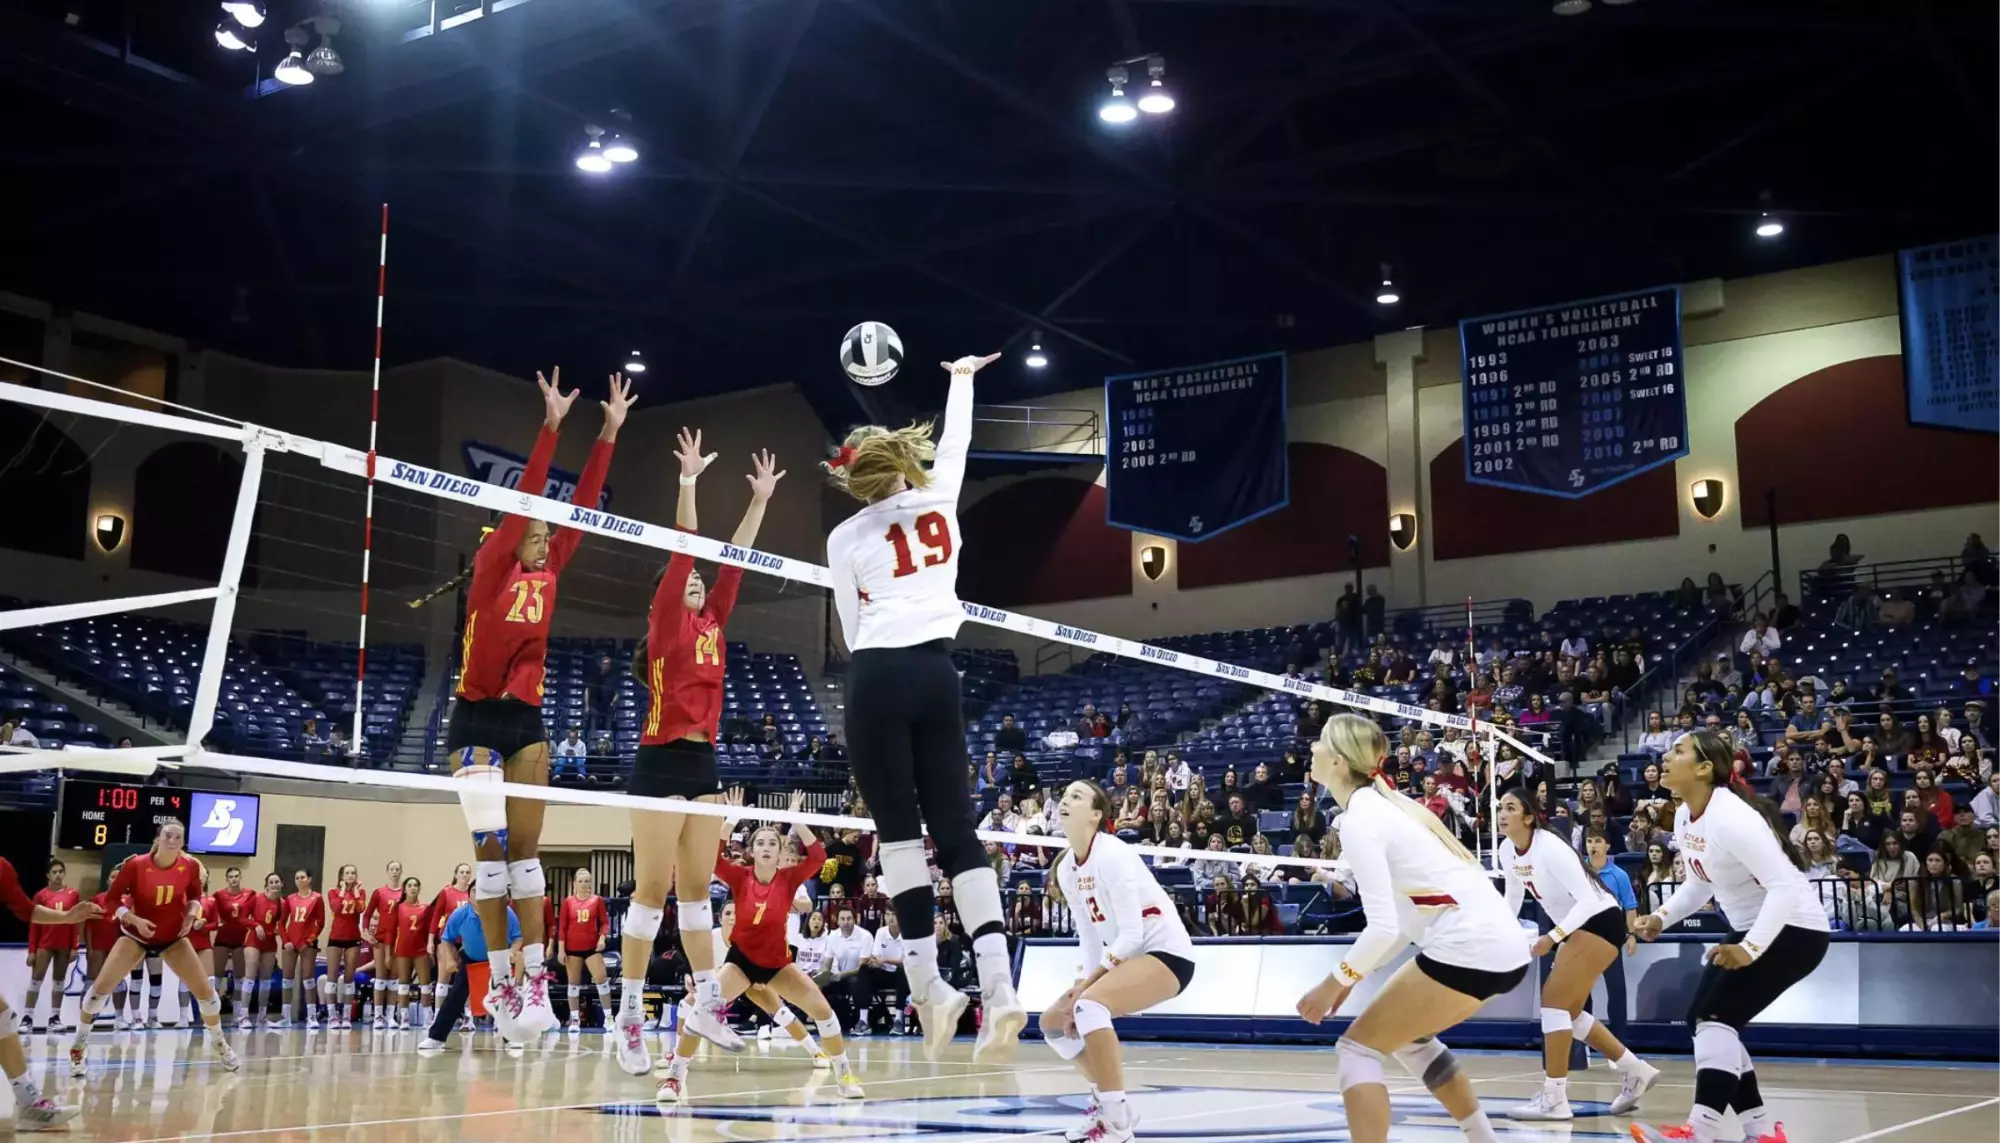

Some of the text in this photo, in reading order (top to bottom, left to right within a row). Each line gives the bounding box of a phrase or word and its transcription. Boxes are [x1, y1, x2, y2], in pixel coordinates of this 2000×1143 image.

[1481, 295, 1658, 335] WOMEN'S VOLLEYBALL
[1497, 313, 1642, 347] NCAA TOURNAMENT
[1576, 334, 1620, 354] 2003
[1469, 351, 1508, 369] 1993
[1628, 350, 1659, 364] SWEET
[1133, 363, 1260, 391] MEN'S BASKETBALL
[1469, 369, 1509, 386] 1996
[1579, 370, 1622, 389] 2005
[1655, 362, 1674, 378] RD
[1136, 376, 1255, 404] NCAA TOURNAMENT
[1539, 380, 1557, 395] RD
[1629, 386, 1660, 400] SWEET
[1661, 383, 1675, 396] 16
[1539, 397, 1558, 413] RD
[1473, 421, 1511, 439] 1999
[1540, 415, 1559, 431] RD
[1122, 438, 1155, 453] 2003
[1473, 439, 1512, 457] 2001
[1541, 433, 1560, 449] RD
[1583, 443, 1624, 461] 2010
[1659, 436, 1679, 451] RD
[1122, 454, 1155, 469] 2008
[1181, 450, 1196, 463] RD
[1473, 457, 1514, 475] 2002
[391, 462, 480, 497] SAN DIEGO
[569, 506, 644, 537] SAN DIEGO
[884, 510, 952, 578] 19
[719, 544, 783, 571] SAN DIEGO
[504, 579, 548, 624] 23
[979, 606, 1007, 623] DIEGO
[1054, 625, 1098, 644] SAN DIEGO
[695, 627, 720, 666] 14
[1140, 645, 1178, 663] SAN DIEGO
[1215, 662, 1249, 679] SAN DIEGO
[1283, 678, 1313, 693] SAN DIEGO
[98, 788, 138, 810] 1:00
[150, 796, 181, 809] PER 4
[82, 810, 105, 821] HOME
[94, 824, 107, 846] 8
[155, 885, 174, 906] 11
[264, 909, 272, 925] 6
[294, 906, 307, 923] 12
[575, 908, 590, 923] 10
[752, 901, 767, 925] 7
[1086, 896, 1106, 923] 12
[409, 915, 418, 931] 2
[1683, 919, 1701, 928] POSS
